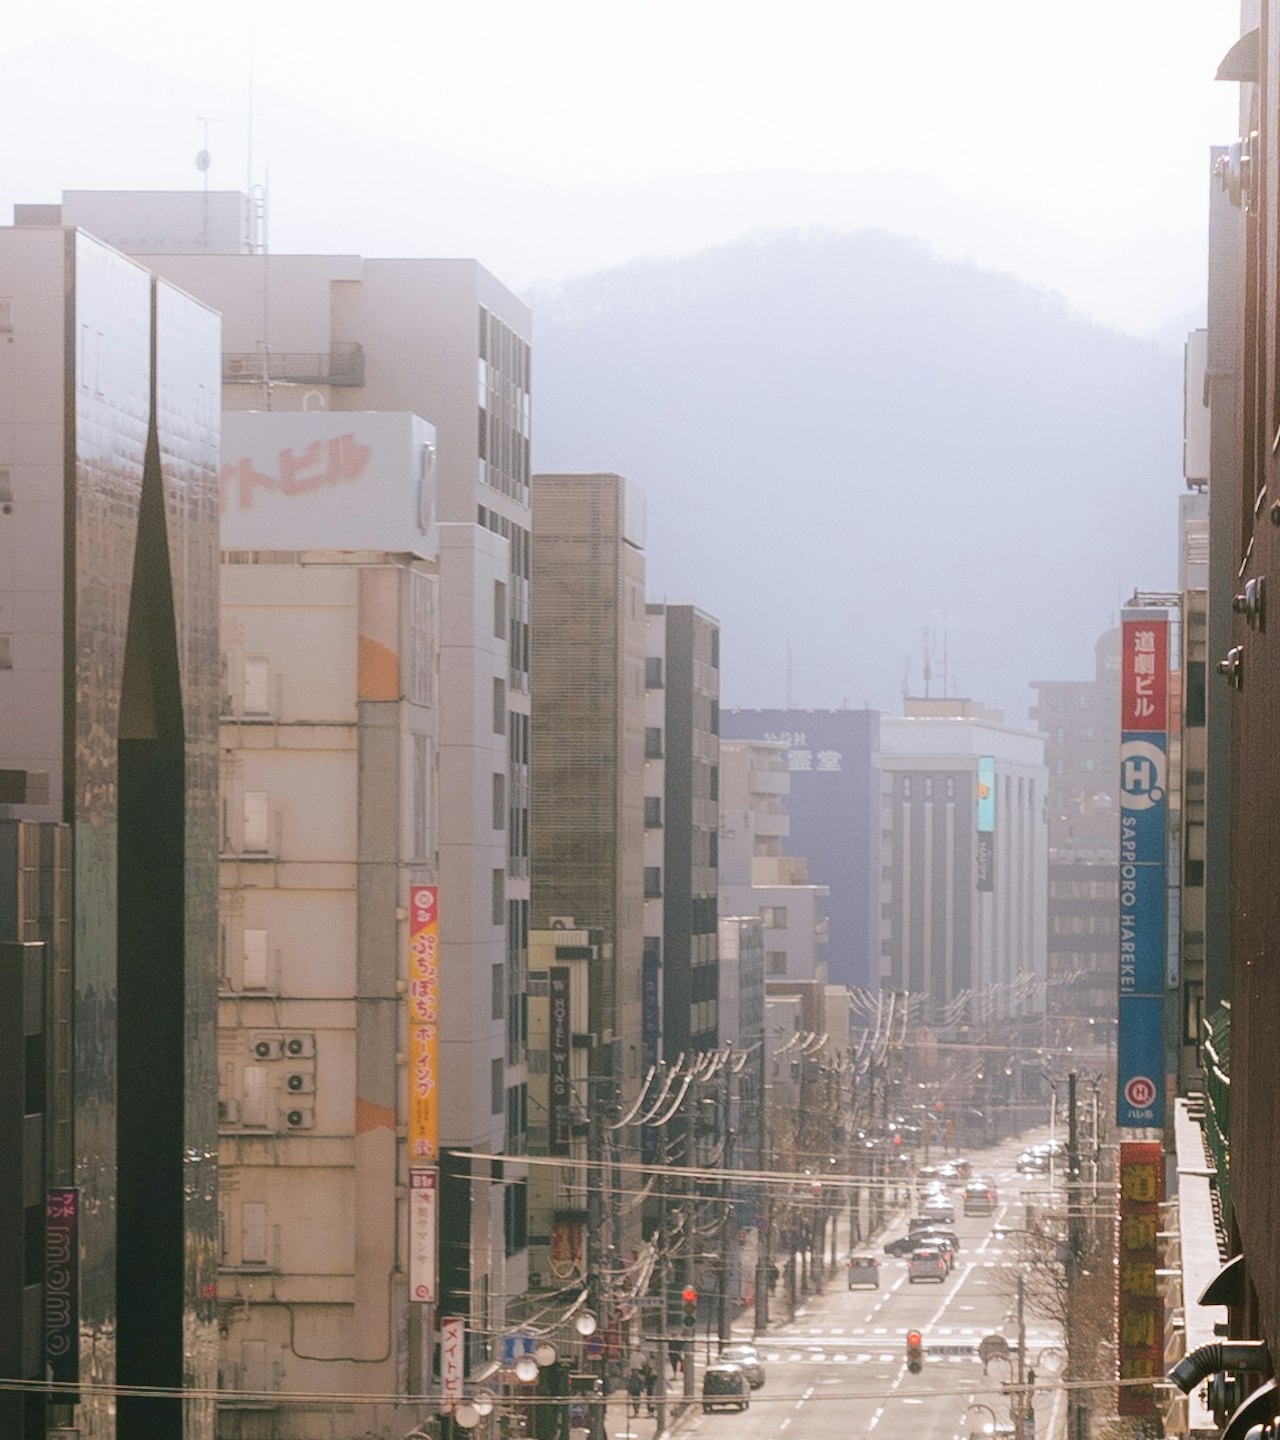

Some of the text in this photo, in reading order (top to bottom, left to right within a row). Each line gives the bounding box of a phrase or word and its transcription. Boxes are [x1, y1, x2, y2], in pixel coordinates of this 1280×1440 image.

[1134, 630, 1156, 718] 道劇ビル
[1121, 817, 1136, 992] SAPPORO HAREKEI
[554, 1053, 567, 1094] WING
